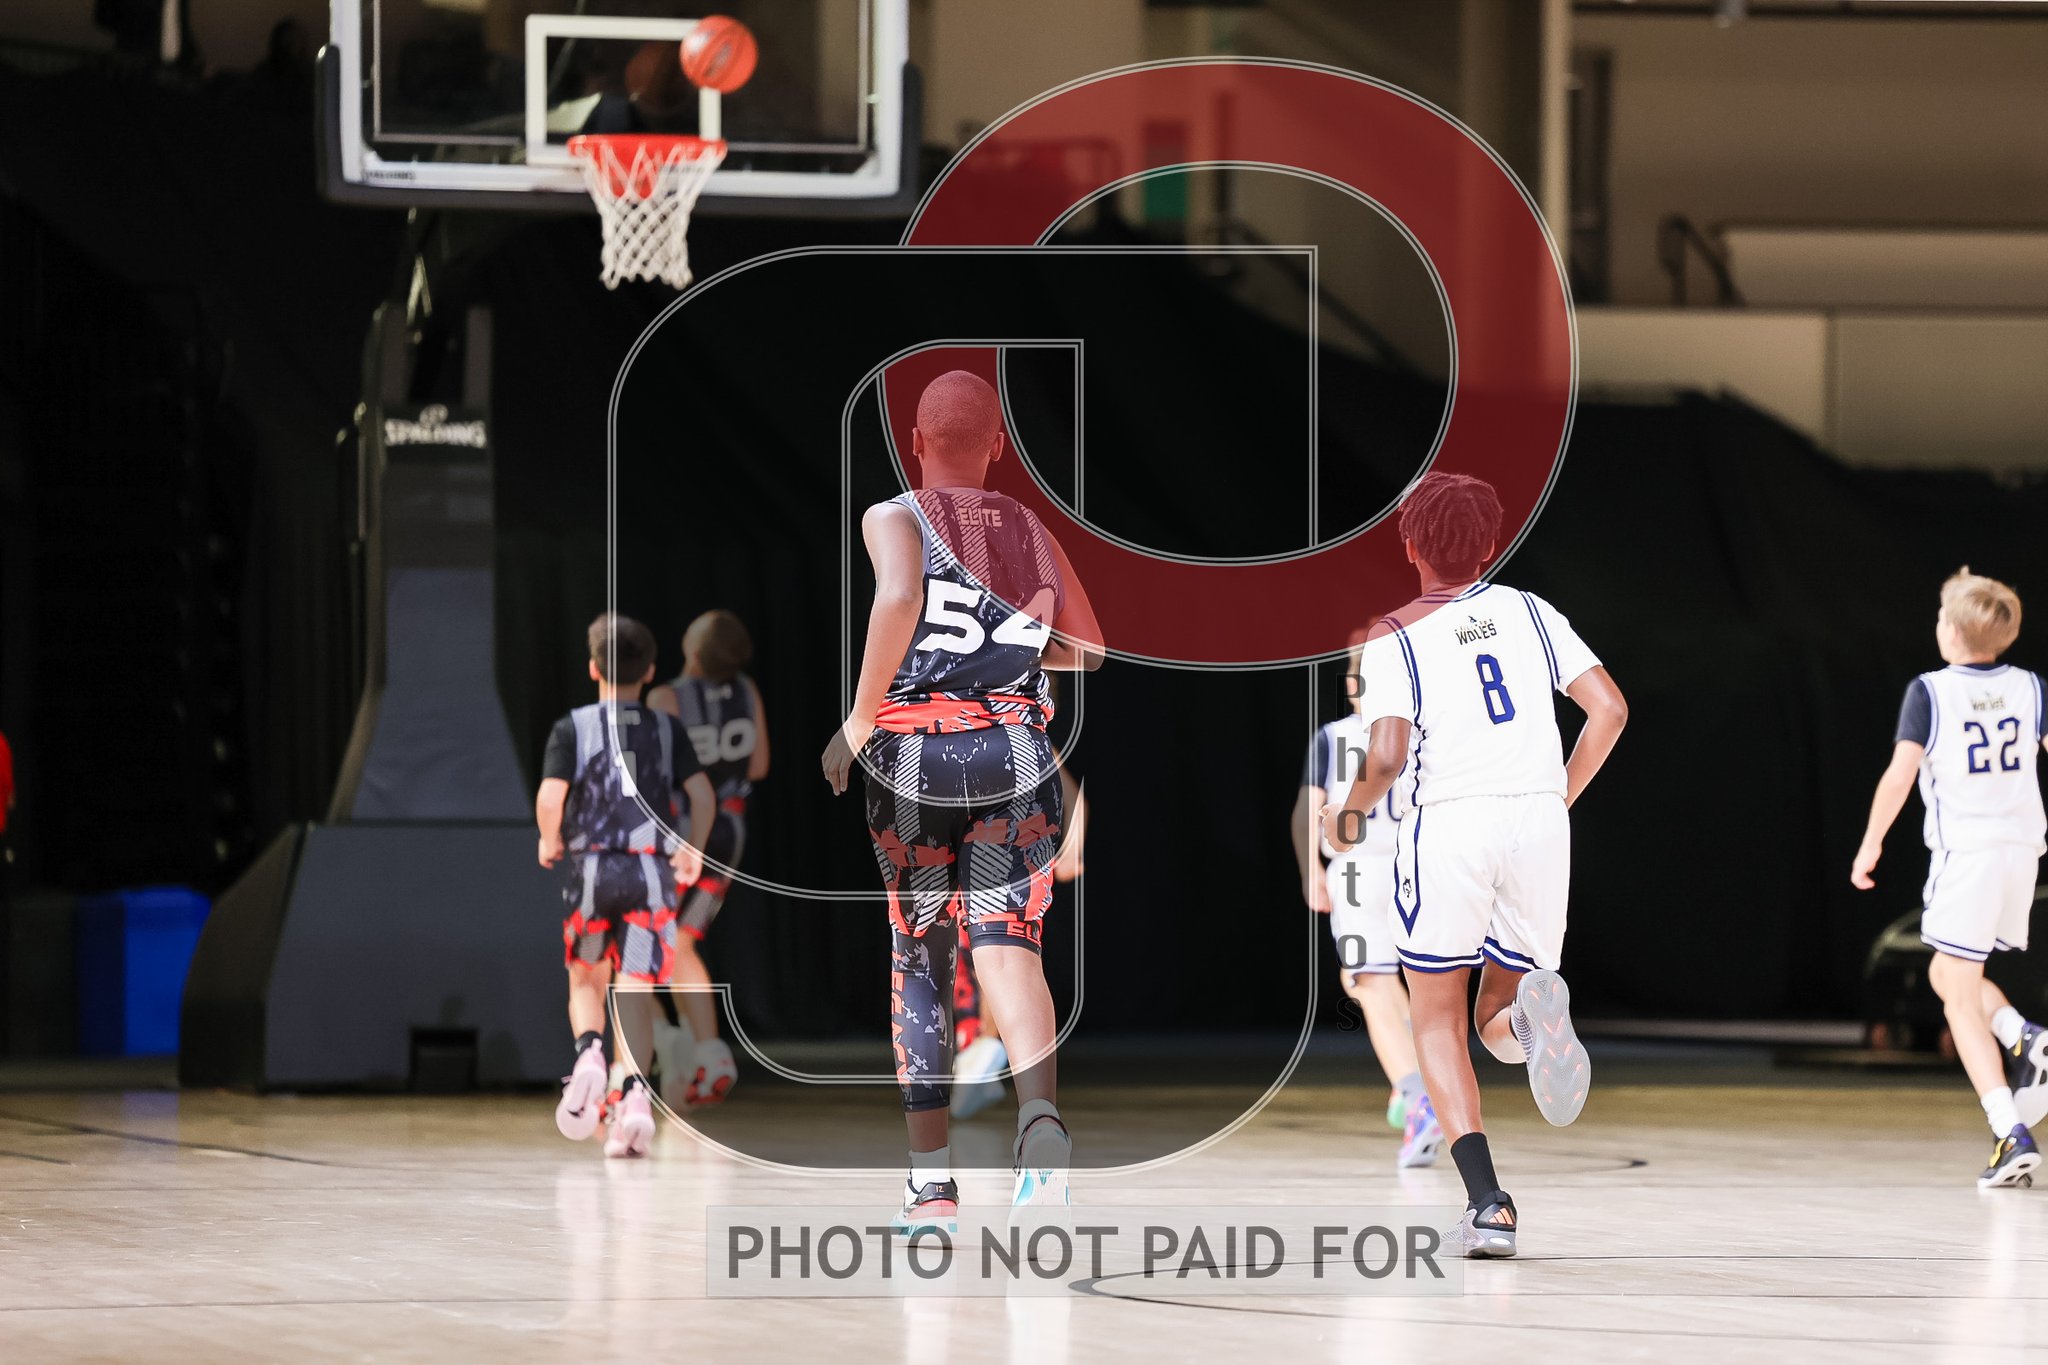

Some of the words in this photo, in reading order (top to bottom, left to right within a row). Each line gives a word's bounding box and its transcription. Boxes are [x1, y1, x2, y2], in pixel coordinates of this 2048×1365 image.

[958, 507, 1003, 527] ELITE
[915, 578, 1056, 658] 54
[1475, 653, 1516, 725] 8
[687, 717, 757, 766] 30
[1964, 716, 2020, 774] 22
